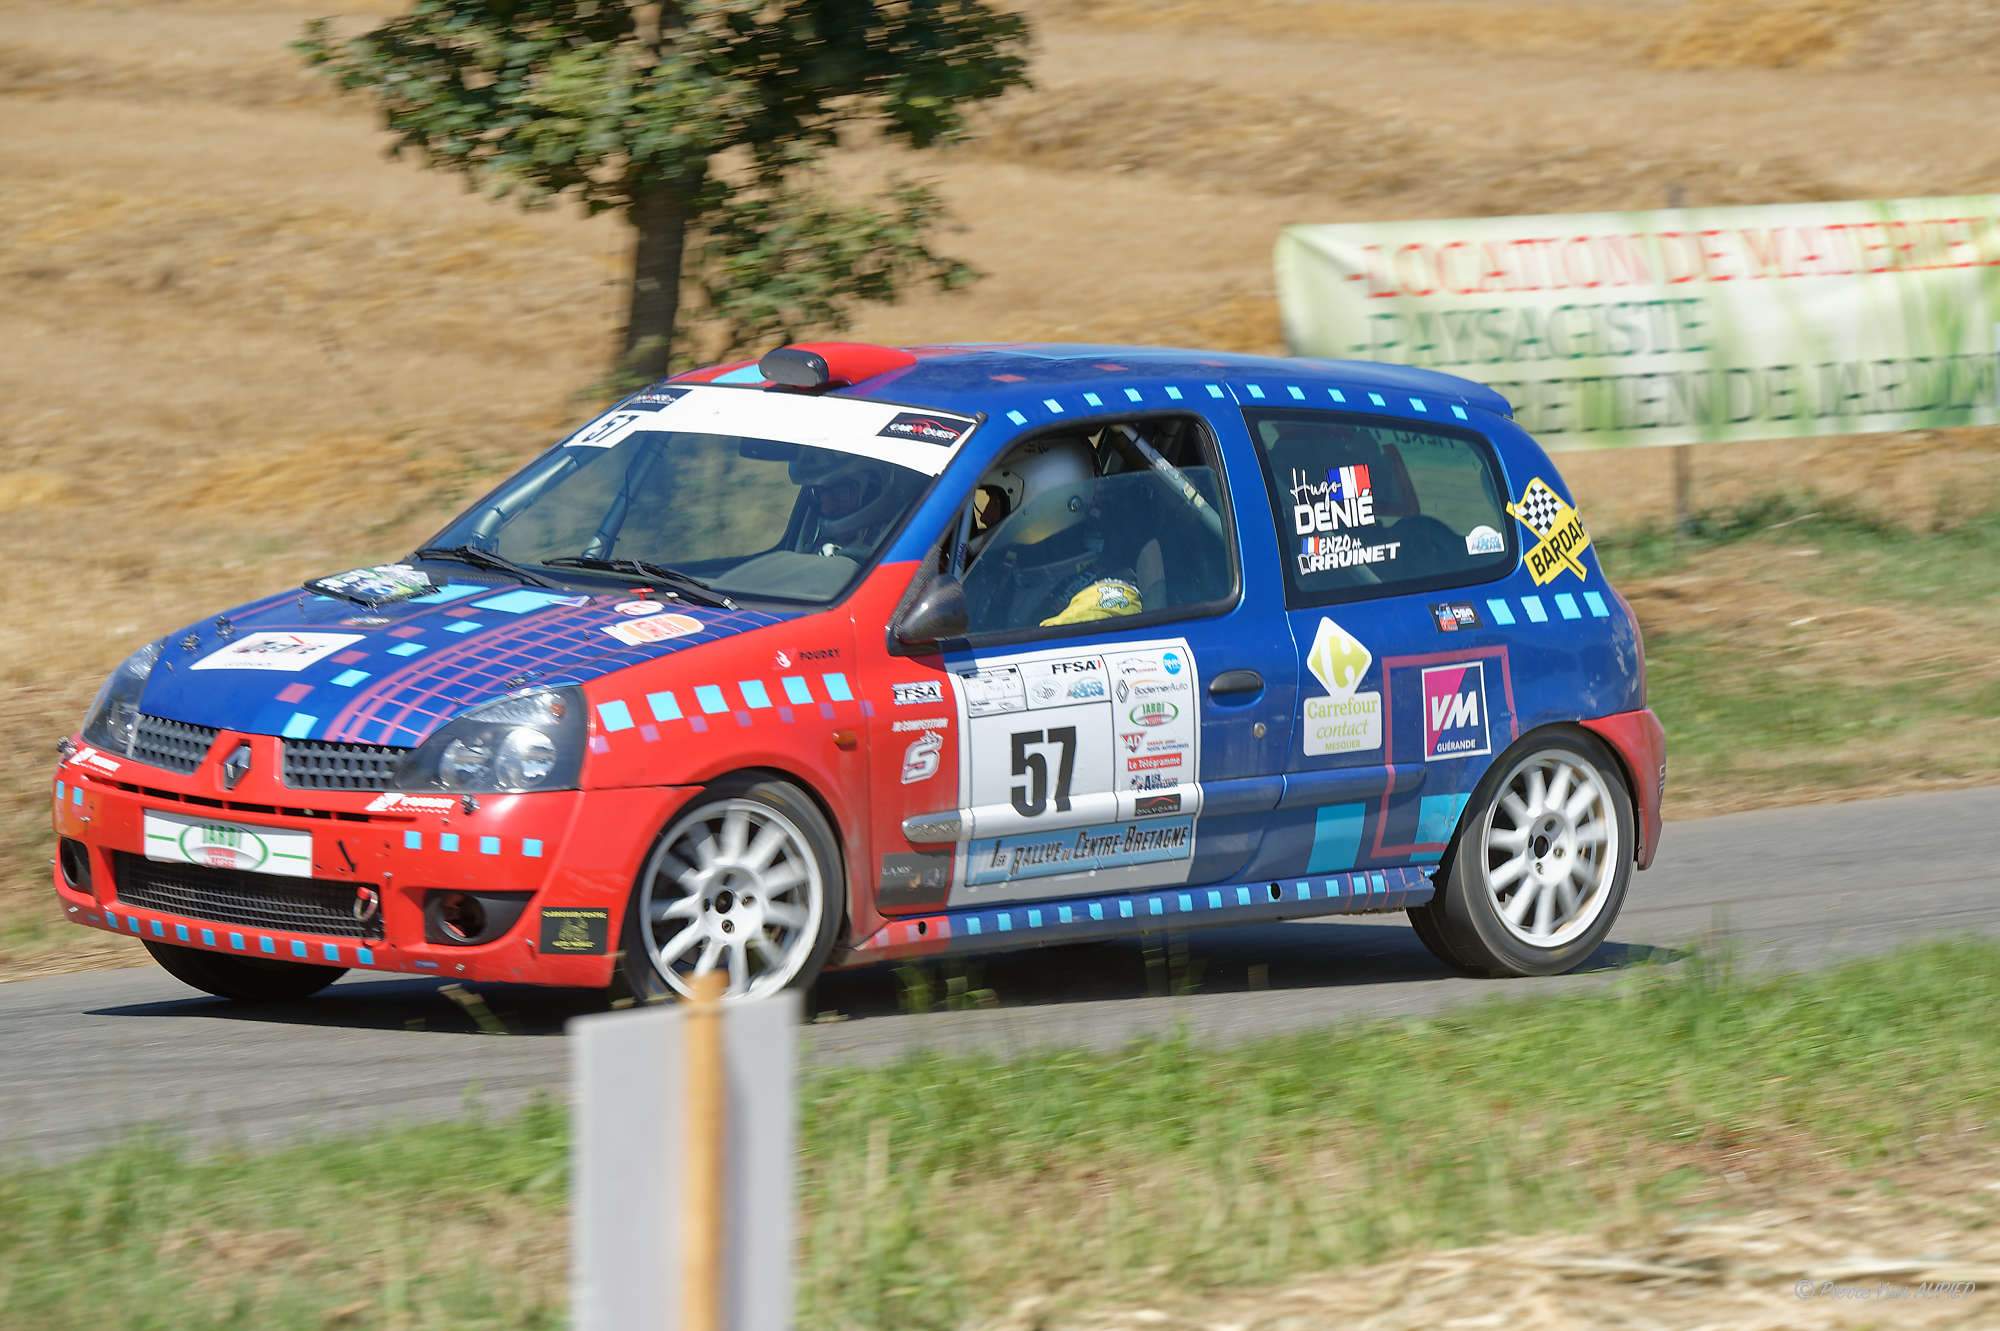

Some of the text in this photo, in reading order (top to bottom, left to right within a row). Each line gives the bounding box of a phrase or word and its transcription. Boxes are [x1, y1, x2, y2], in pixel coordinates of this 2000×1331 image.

[1656, 228, 1735, 284] DE
[1350, 297, 1711, 369] PAYSAGISTE
[1290, 467, 1343, 512] Hugo
[1294, 488, 1376, 536] DENIÉ
[1319, 534, 1351, 556] ENZO
[1051, 659, 1097, 674] FFSA
[894, 685, 937, 700] FFSA
[1307, 697, 1379, 720] Carrefour
[1431, 691, 1478, 732] VM
[1316, 720, 1369, 740] contact
[1436, 738, 1476, 753] GUÉRANDE
[1010, 725, 1077, 818] 57
[1010, 841, 1063, 876] RALLYE
